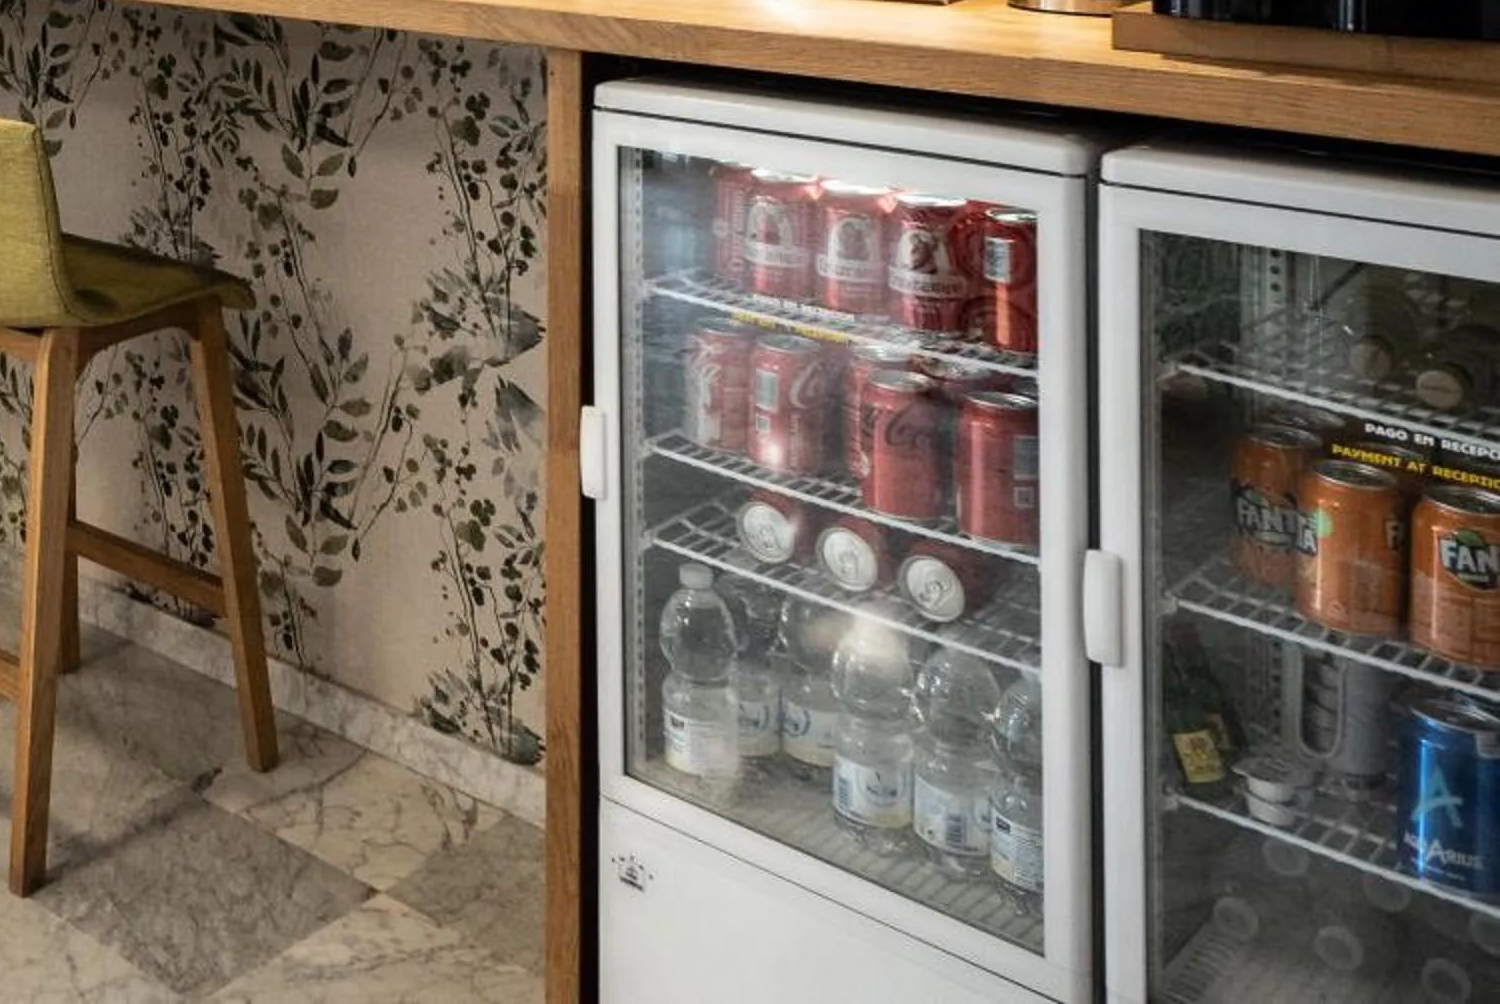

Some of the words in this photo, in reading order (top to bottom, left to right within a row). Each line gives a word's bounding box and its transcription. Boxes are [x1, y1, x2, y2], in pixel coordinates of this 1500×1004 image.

[1364, 422, 1408, 441] PAGO
[1414, 433, 1434, 446] EN
[1332, 443, 1400, 468] PAYMENT
[1406, 460, 1427, 474] AT
[1237, 496, 1299, 535] FANT
